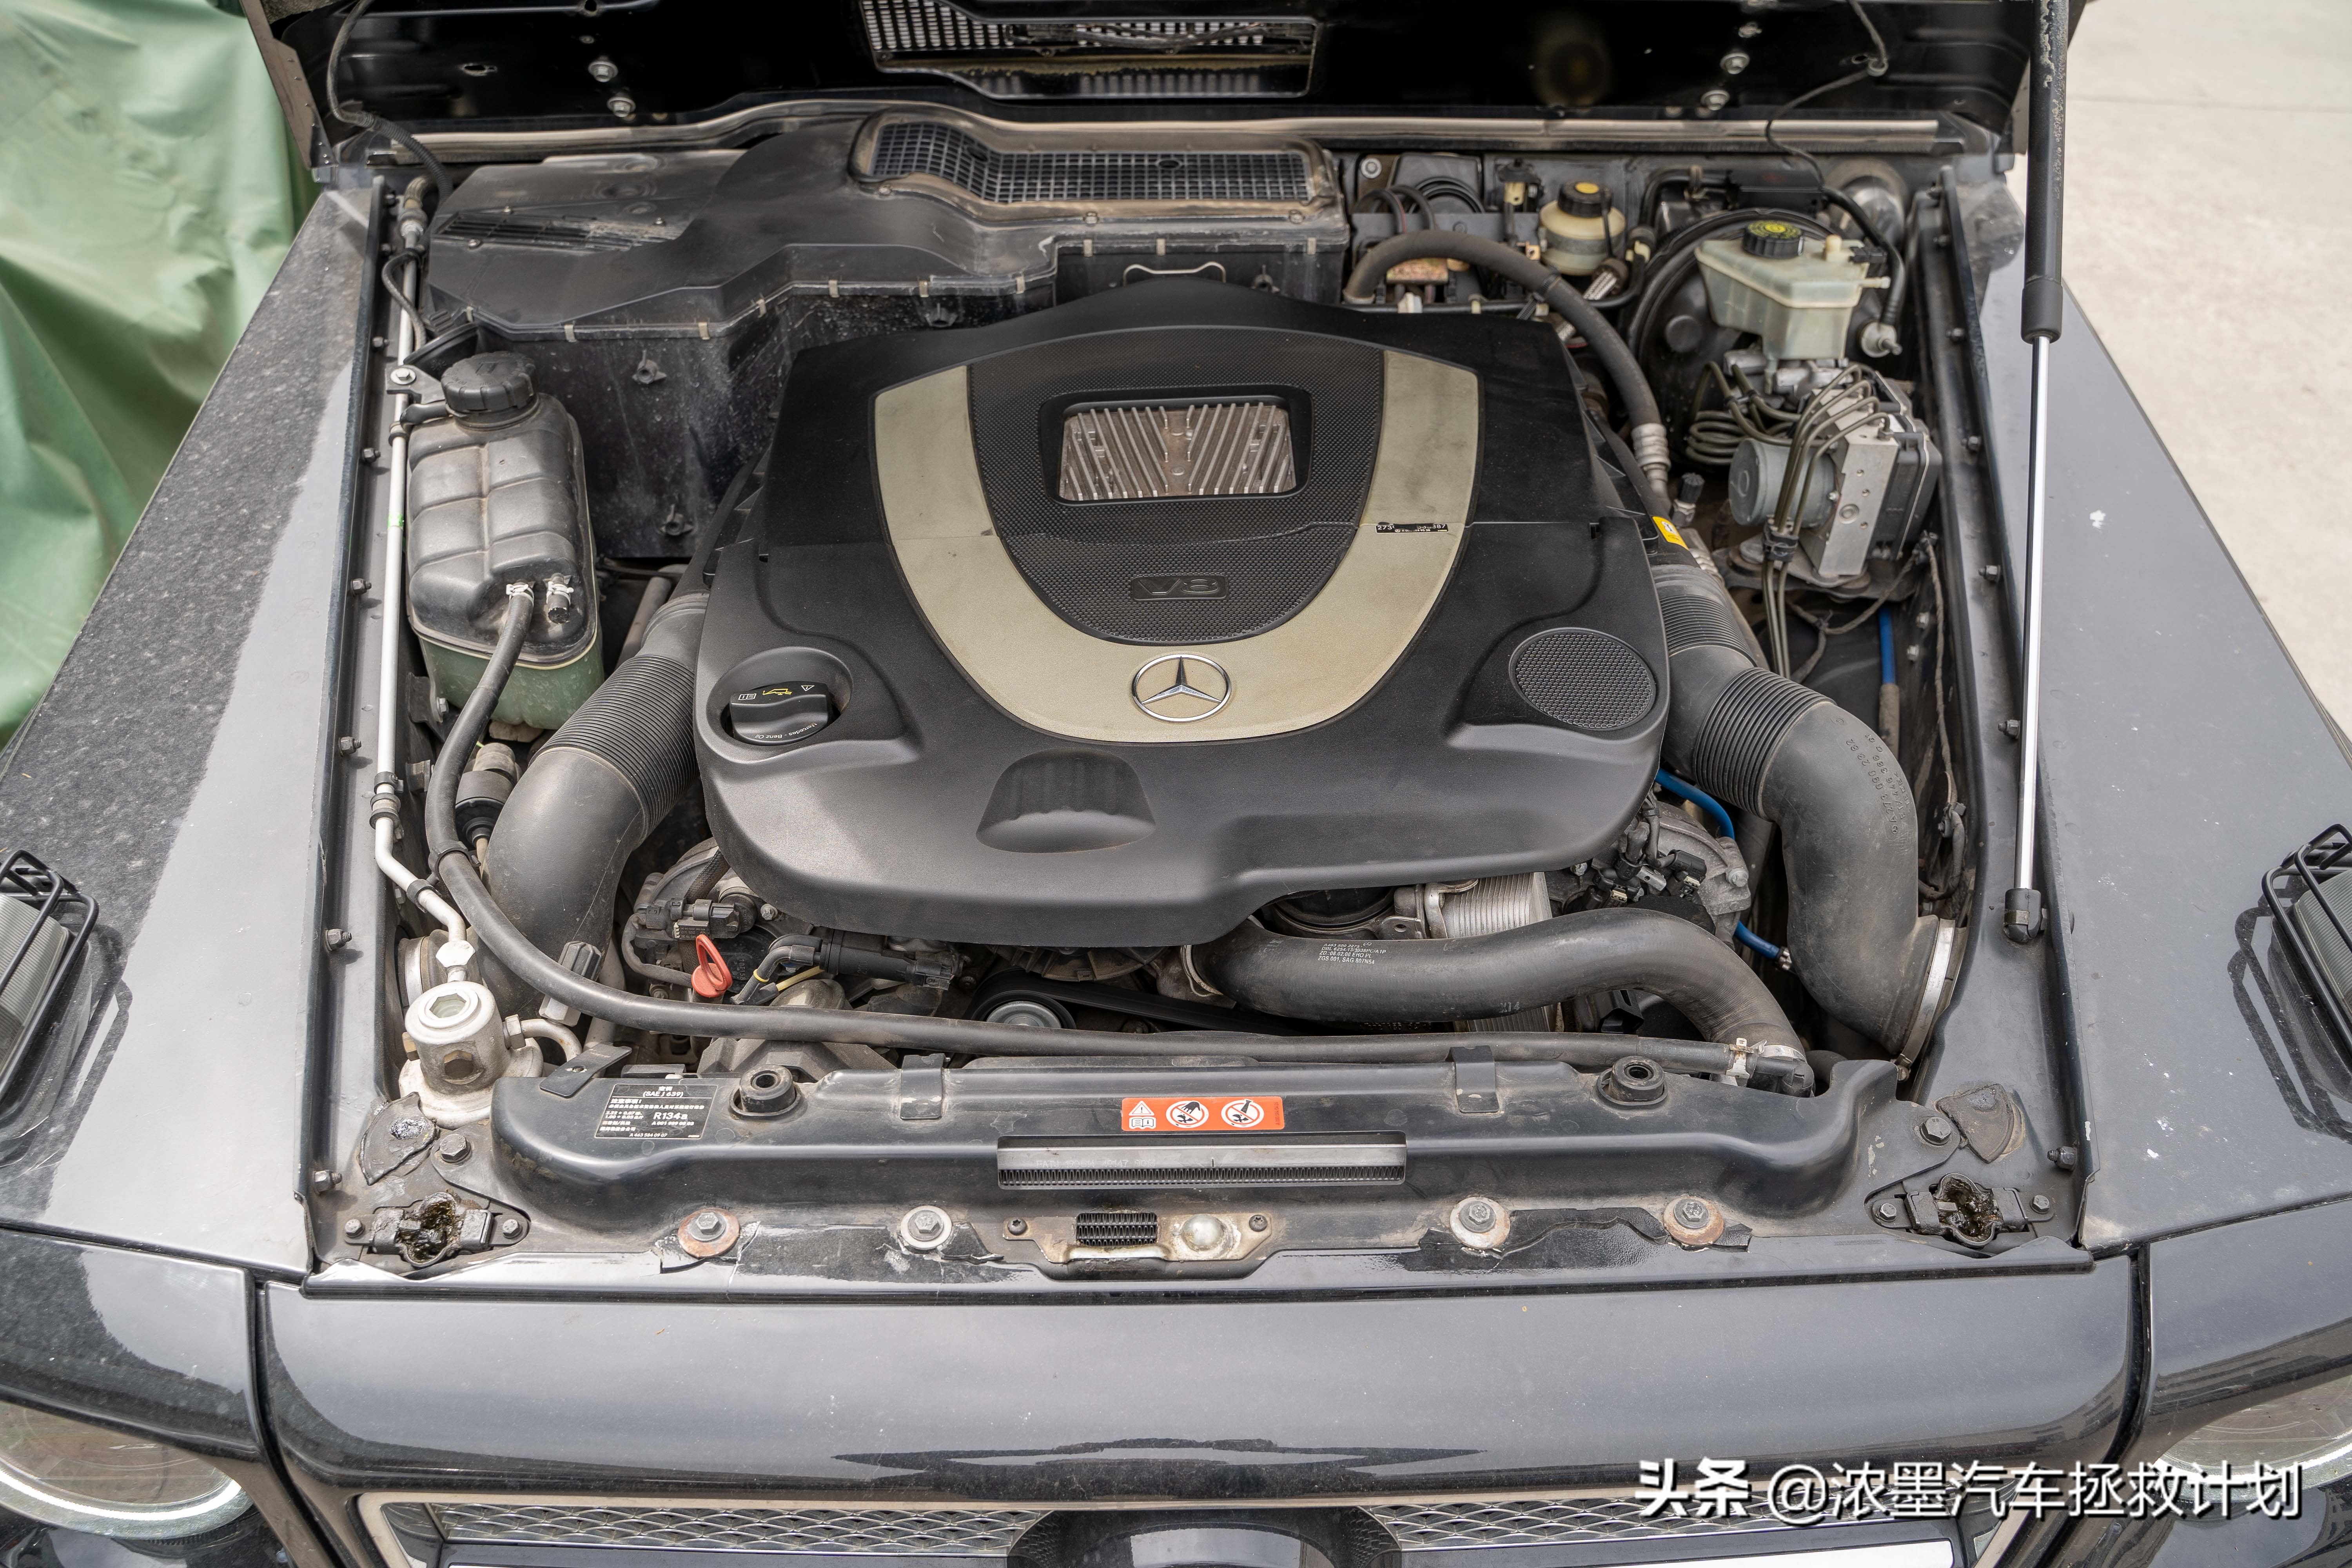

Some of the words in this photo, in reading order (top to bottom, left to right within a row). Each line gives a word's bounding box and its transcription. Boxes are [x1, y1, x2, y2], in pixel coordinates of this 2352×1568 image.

[1138, 578, 1219, 595] V8
[788, 722, 817, 736] Mercedes
[653, 1111, 688, 1120] R134a
